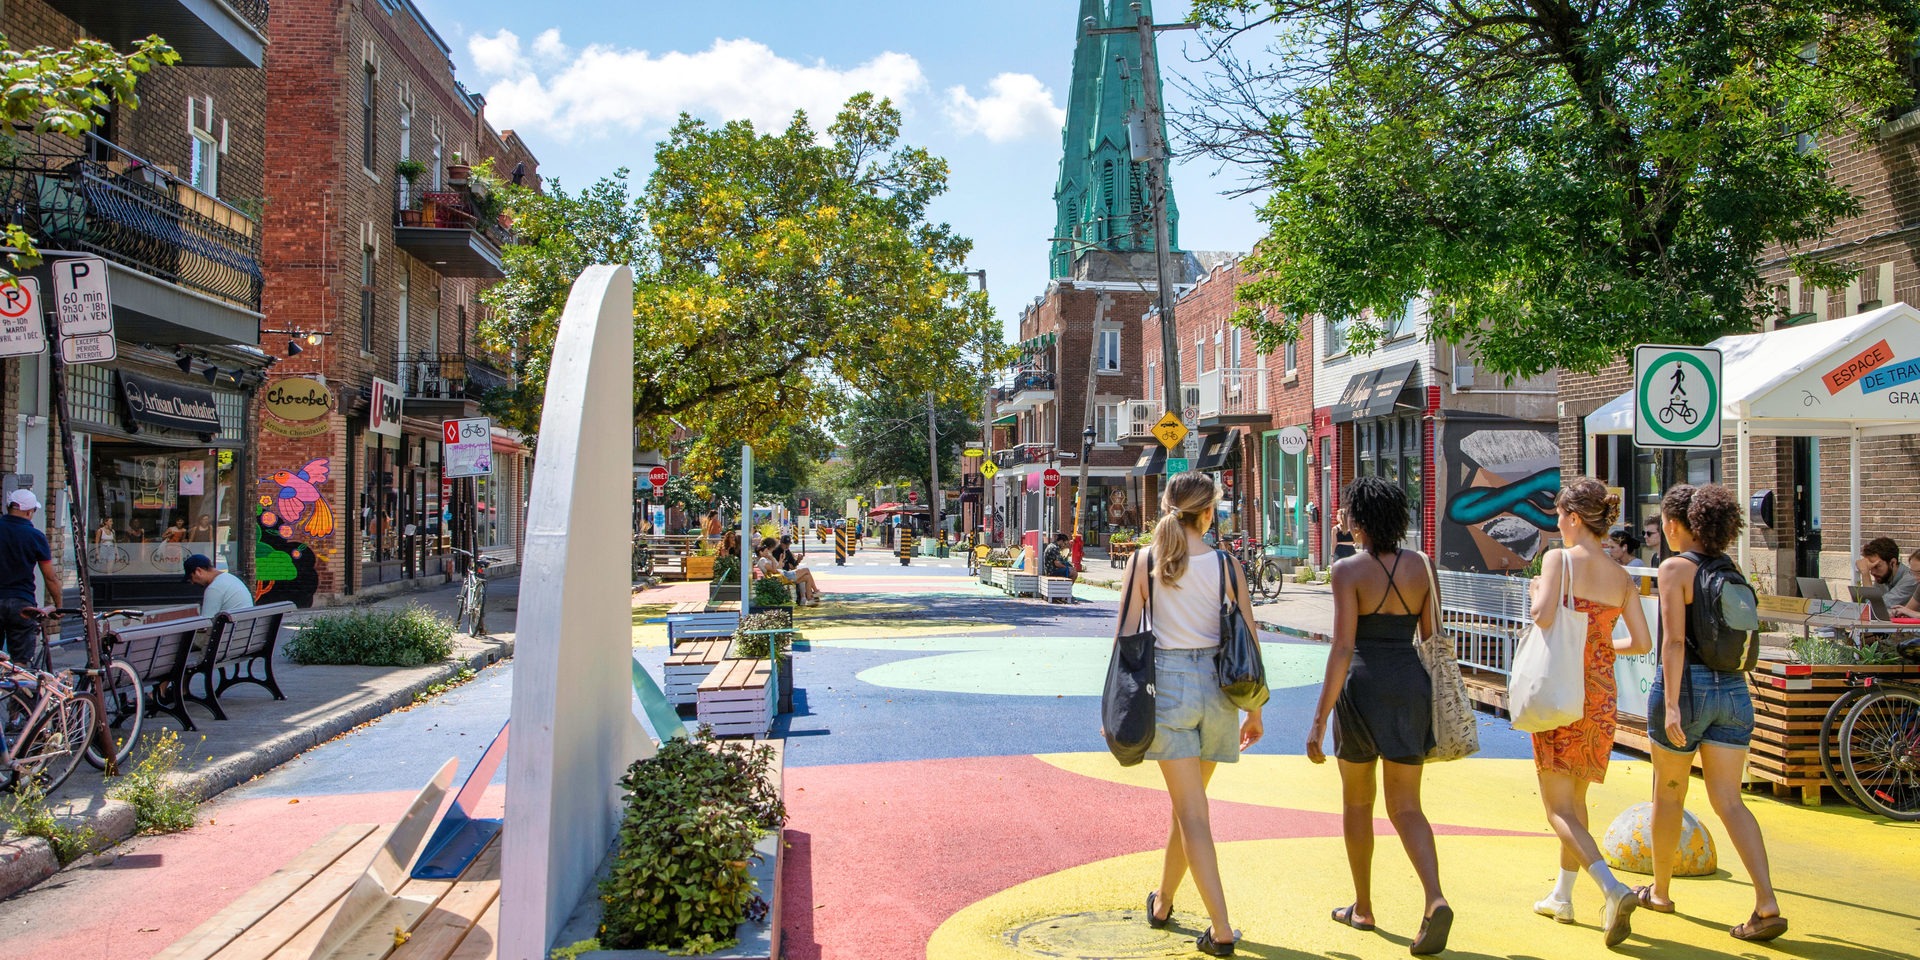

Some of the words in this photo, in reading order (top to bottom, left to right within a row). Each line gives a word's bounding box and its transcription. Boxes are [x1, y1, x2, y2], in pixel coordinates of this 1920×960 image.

[71, 262, 90, 289] P
[63, 292, 78, 304] 60
[83, 290, 103, 302] min
[62, 303, 84, 314] 9h30
[91, 302, 106, 311] 18h
[63, 313, 79, 323] LUN
[90, 311, 107, 321] VEN
[5, 325, 27, 334] MARDI
[1832, 348, 1884, 387] ESPACE
[1864, 372, 1884, 389] DE
[267, 386, 330, 410] Chocobel
[1888, 391, 1920, 404] GRA
[143, 390, 174, 414] Artisan
[172, 396, 217, 420] Chocolatier
[1282, 436, 1304, 445] BOA
[650, 472, 668, 480] ARRÊT
